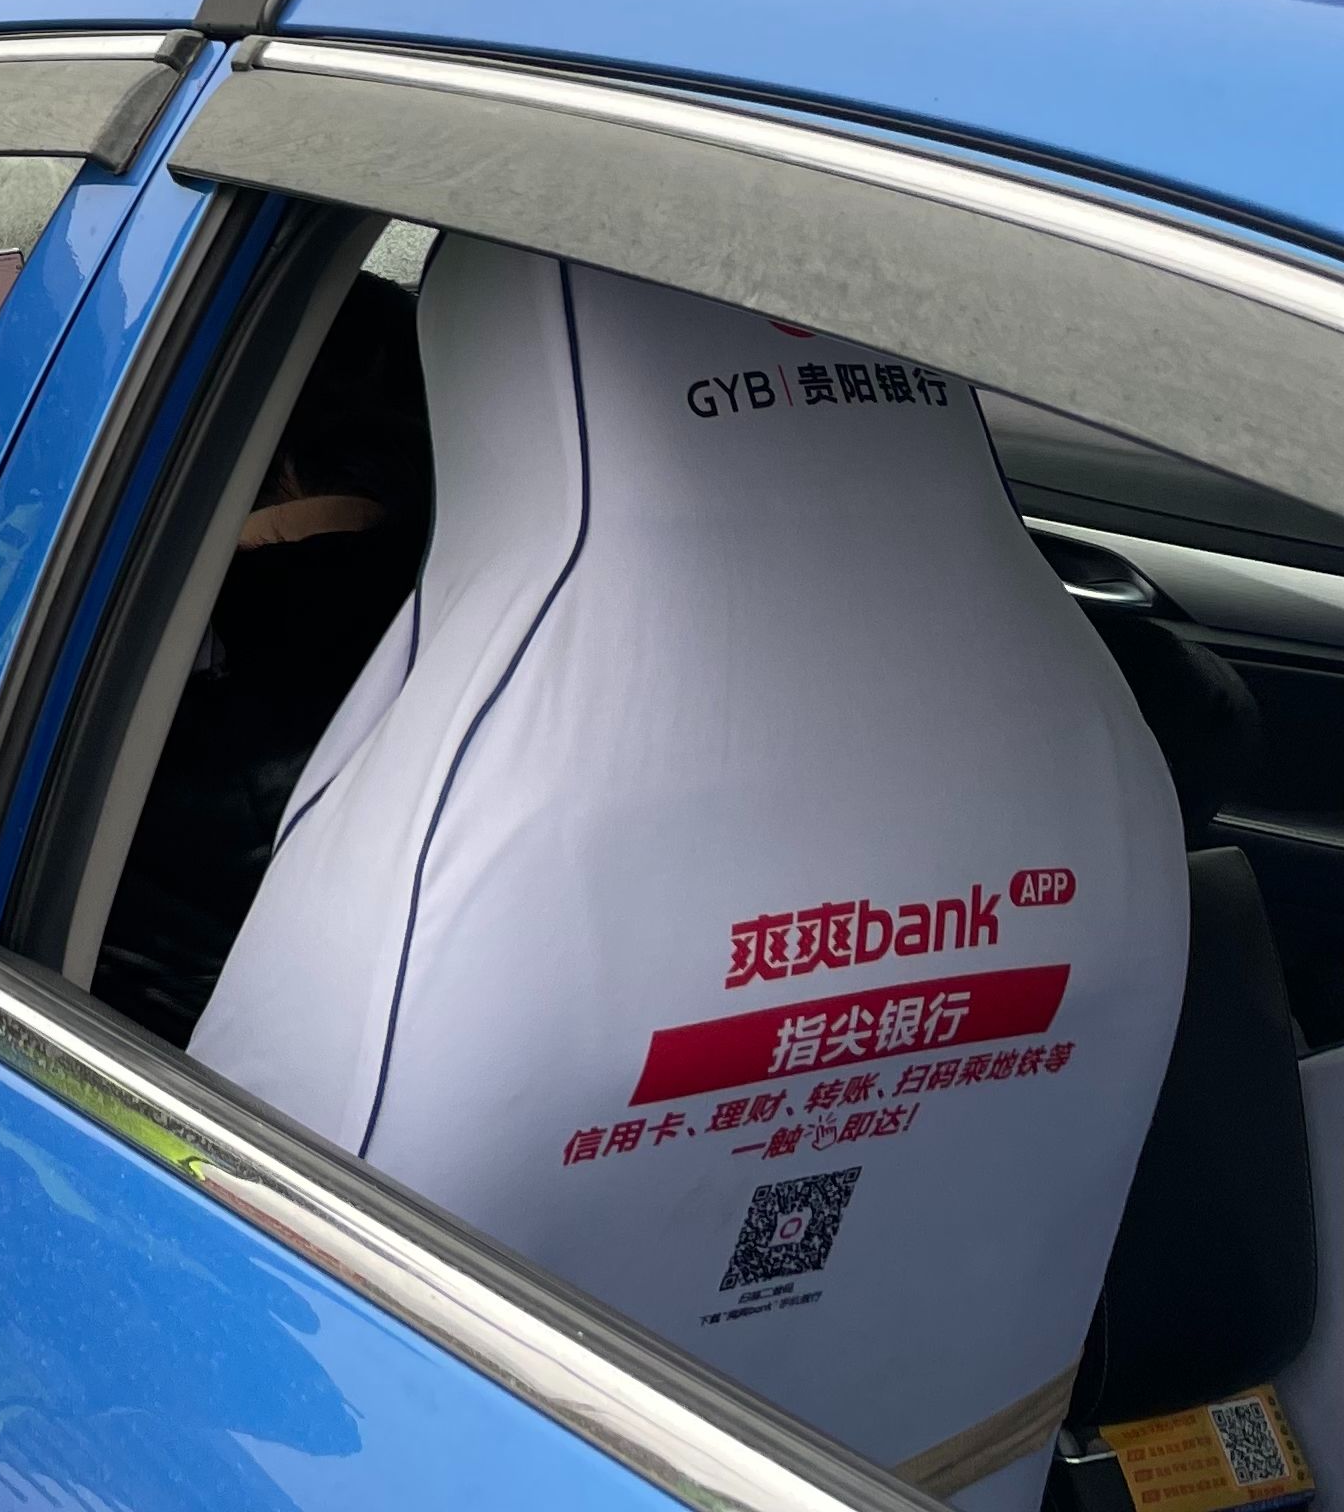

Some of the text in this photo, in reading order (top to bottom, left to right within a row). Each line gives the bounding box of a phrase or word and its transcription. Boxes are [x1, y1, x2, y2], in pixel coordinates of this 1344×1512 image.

[686, 362, 950, 419] GYB 贵阳银行
[725, 871, 1069, 990] 爽爽bank APP
[767, 991, 972, 1075] 指尖银行
